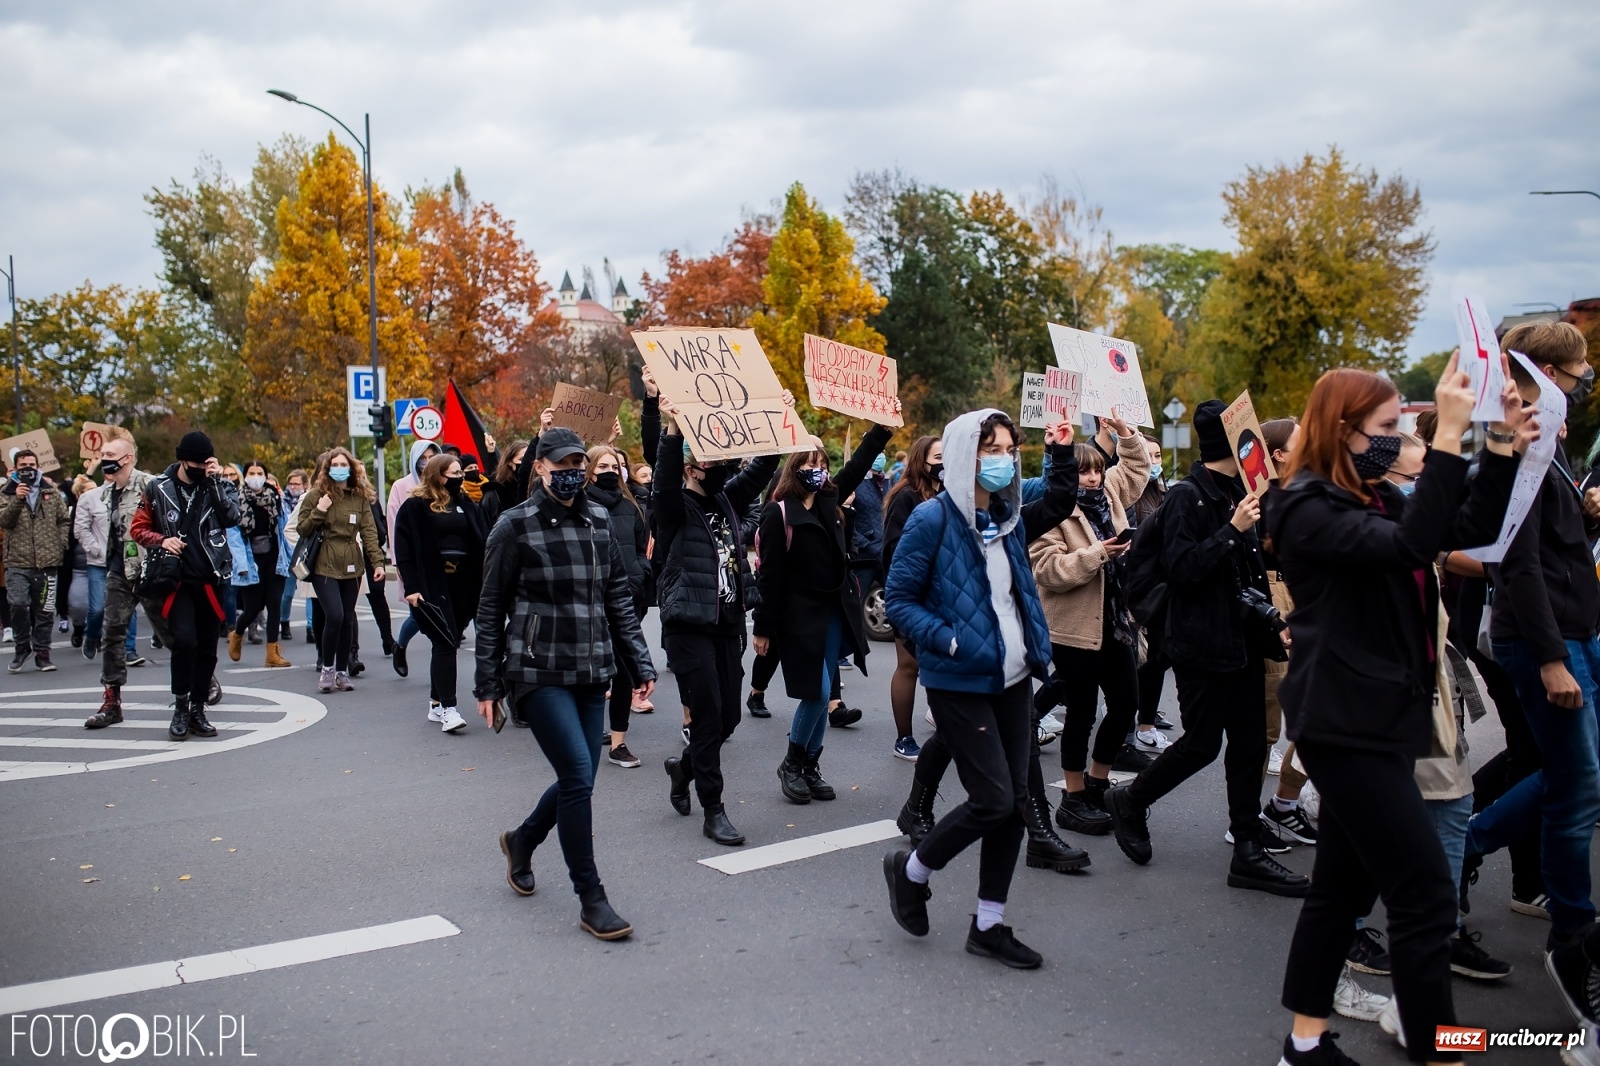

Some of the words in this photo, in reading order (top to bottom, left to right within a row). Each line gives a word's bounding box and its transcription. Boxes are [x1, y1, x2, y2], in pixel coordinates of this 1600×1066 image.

[656, 334, 741, 373] WARA
[808, 336, 826, 366] NIE
[827, 342, 874, 371] ODDAMY
[695, 373, 749, 411] OD
[812, 362, 859, 393] NASZYCH
[1027, 377, 1045, 387] NAWET
[562, 387, 596, 404] JESTEM
[600, 395, 614, 409] ZA
[416, 416, 439, 431] 3,5t
[684, 410, 783, 452] KOBIET
